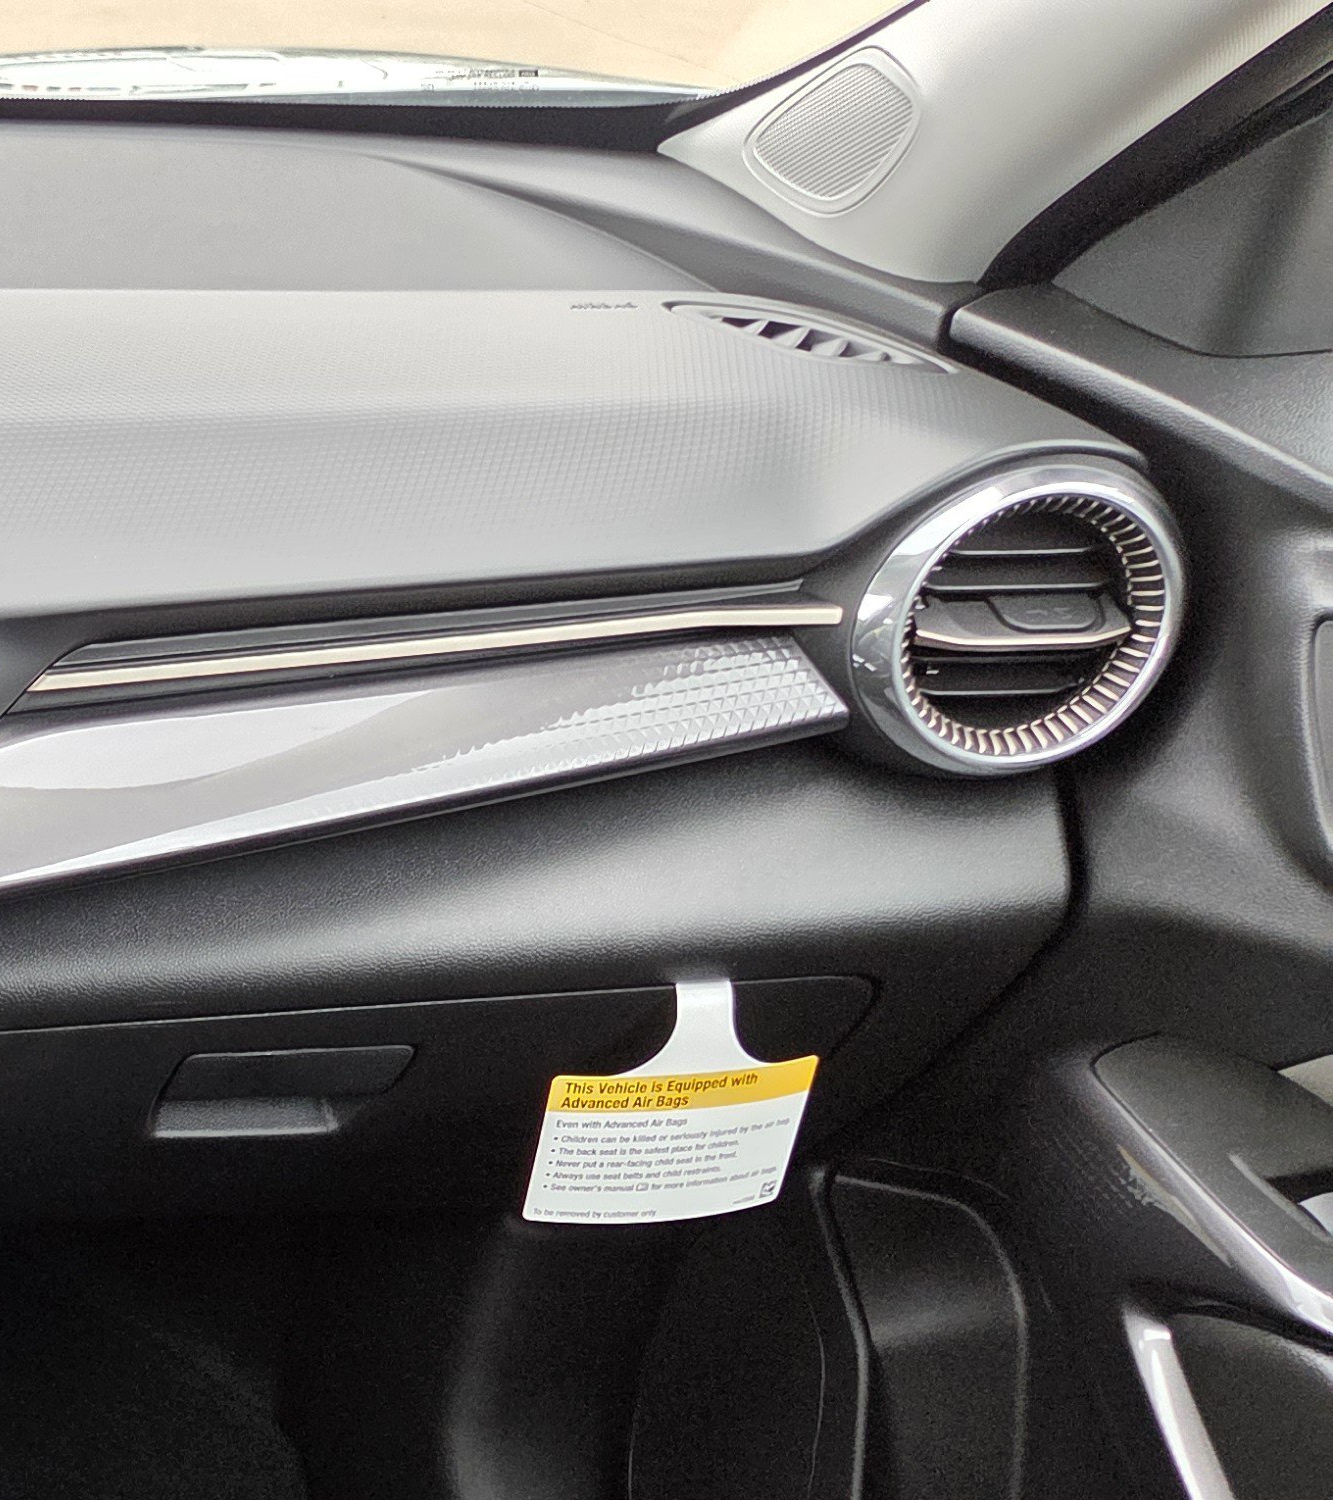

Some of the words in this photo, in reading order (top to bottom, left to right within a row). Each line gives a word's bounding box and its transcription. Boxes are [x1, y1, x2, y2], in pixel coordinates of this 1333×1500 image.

[565, 1082, 594, 1094] This
[599, 1082, 647, 1094] Vehicle
[651, 1081, 663, 1093] is
[666, 1076, 727, 1093] Equipped
[732, 1073, 759, 1088] with
[560, 1097, 630, 1109] Advanced
[633, 1096, 653, 1108] Air
[656, 1095, 690, 1109] Bags
[556, 1119, 579, 1129] Even
[581, 1120, 601, 1129] with
[603, 1119, 648, 1128] Advanced
[651, 1119, 664, 1127] Air
[665, 1118, 688, 1128] Bags
[561, 1135, 598, 1144] Children
[601, 1136, 617, 1144] can
[619, 1135, 630, 1144] be
[633, 1134, 657, 1143] killed
[670, 1131, 708, 1141] seriously
[710, 1126, 738, 1137] injured
[739, 1126, 749, 1135] by
[559, 1147, 574, 1155] The
[576, 1147, 597, 1156] back
[599, 1148, 618, 1156] seat
[629, 1147, 642, 1155] the
[670, 1145, 692, 1154] place
[555, 1160, 580, 1168] Never
[582, 1160, 597, 1169] put
[606, 1159, 652, 1169] rear-facing
[552, 1172, 584, 1181] Always
[603, 1172, 621, 1180] seat
[645, 1171, 661, 1179] and
[550, 1183, 566, 1191] See
[544, 1208, 554, 1216] be
[555, 1210, 590, 1218] removed
[603, 1210, 639, 1218] customer
